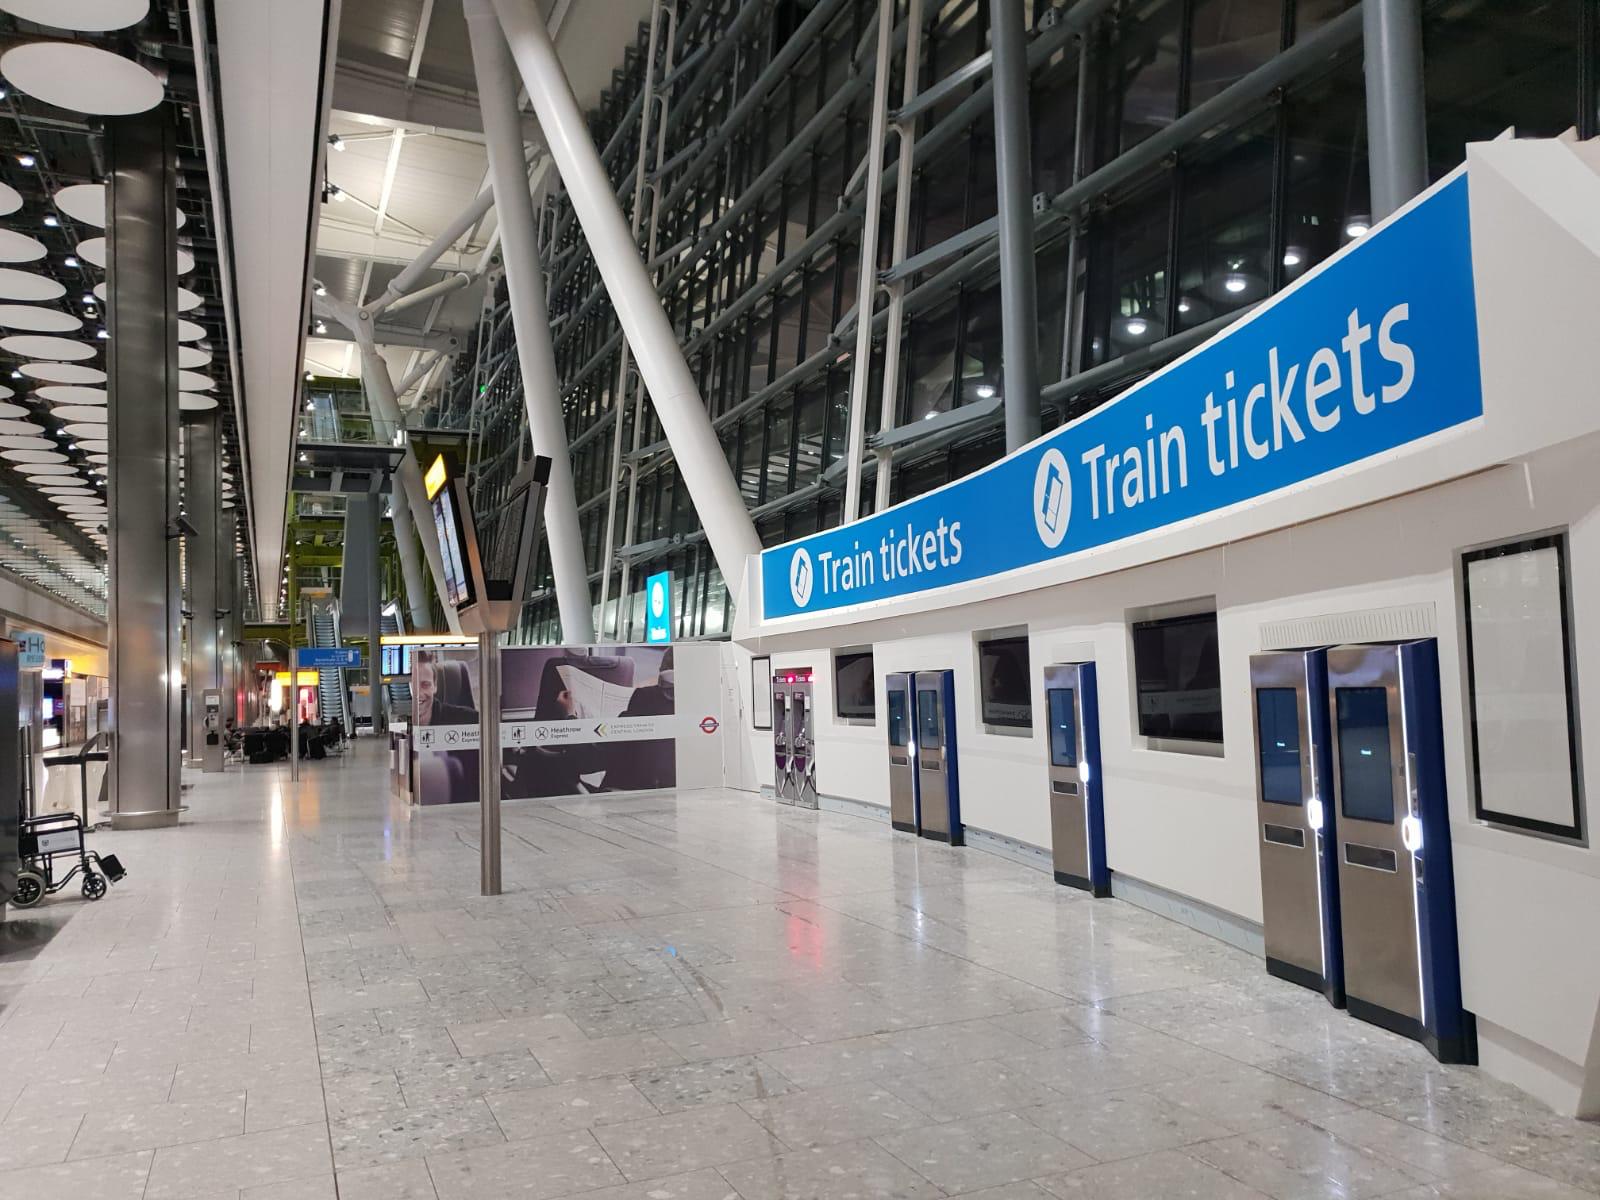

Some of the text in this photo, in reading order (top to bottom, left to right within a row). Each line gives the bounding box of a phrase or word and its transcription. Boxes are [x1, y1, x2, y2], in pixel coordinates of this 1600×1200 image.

[1081, 302, 1416, 520] Train tickets
[818, 516, 962, 594] Train tickets
